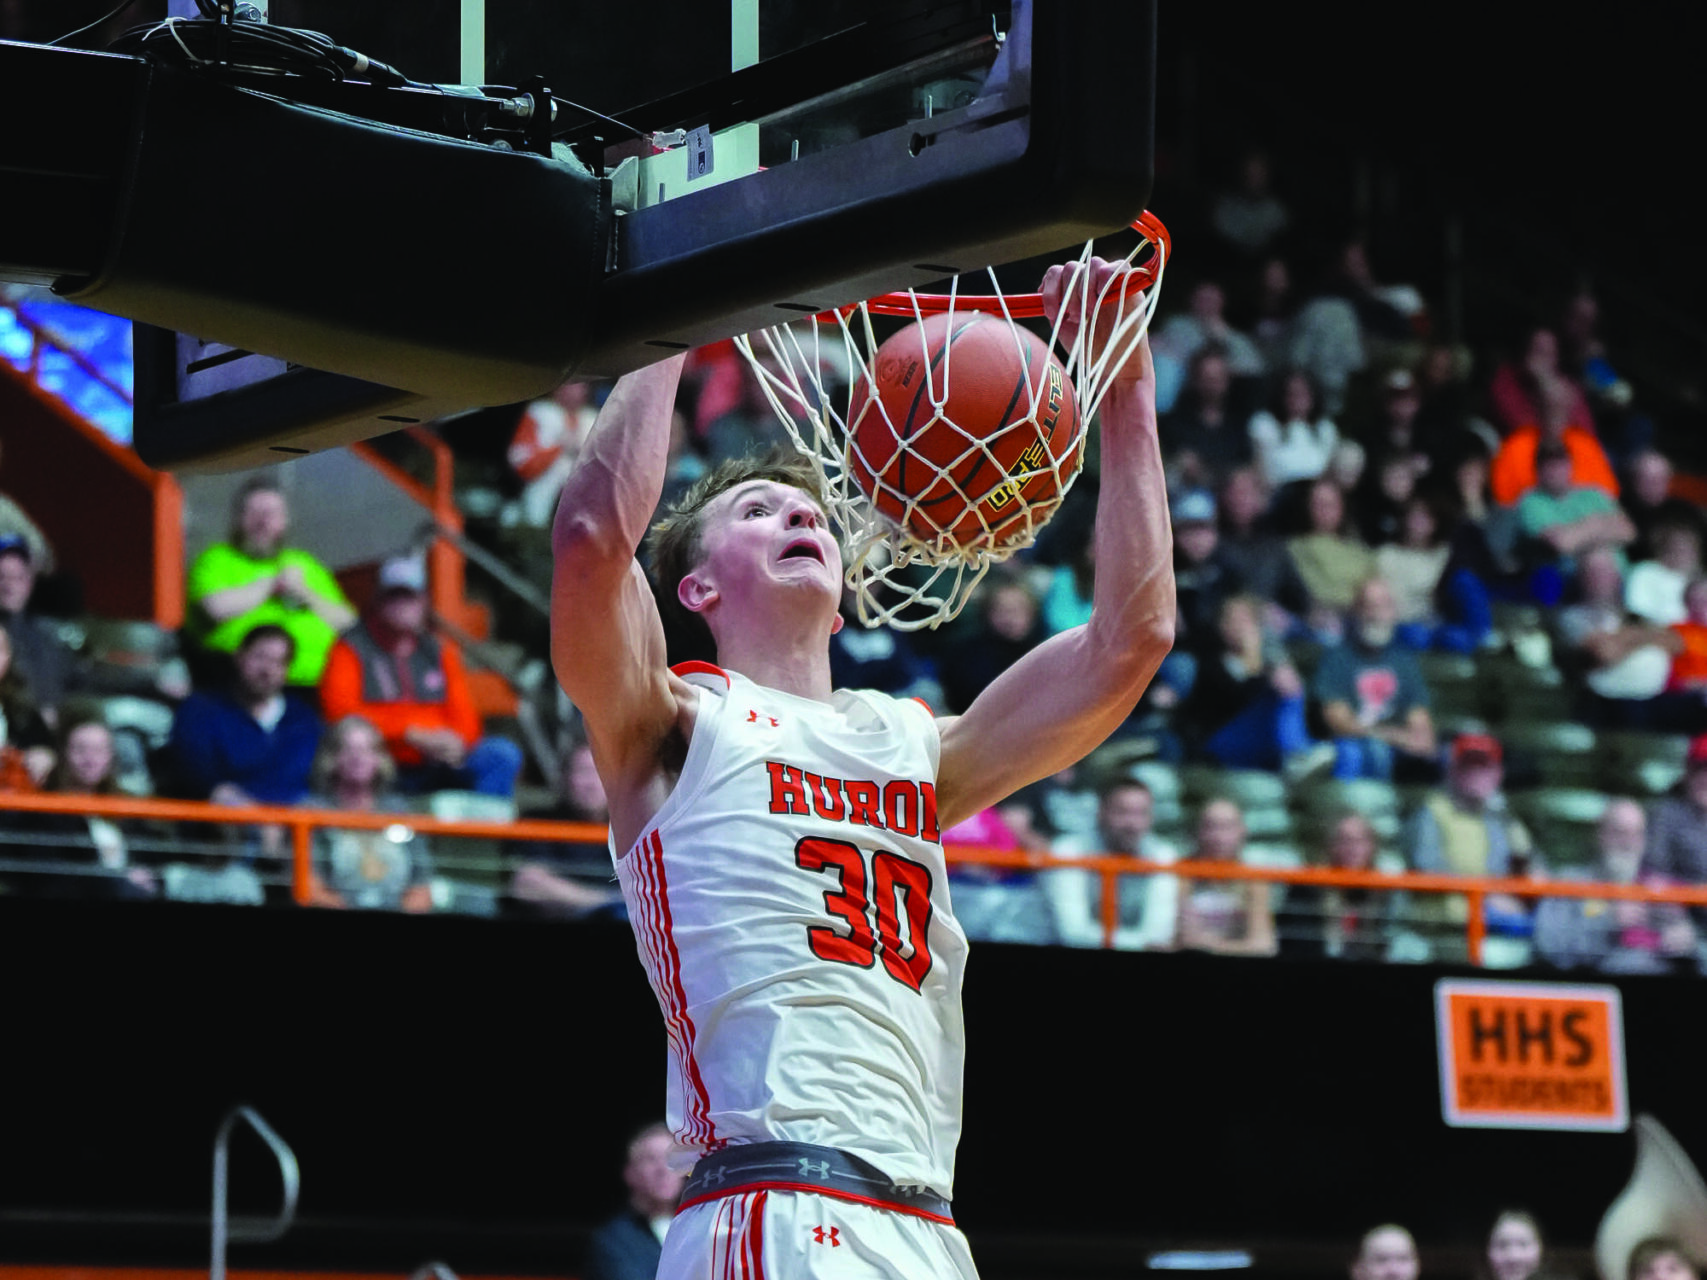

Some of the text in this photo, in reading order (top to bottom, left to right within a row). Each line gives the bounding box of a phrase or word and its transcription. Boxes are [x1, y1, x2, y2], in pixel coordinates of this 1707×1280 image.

[1024, 362, 1063, 467] ELITE
[794, 836, 933, 996] 30
[1469, 1006, 1594, 1067] HHS
